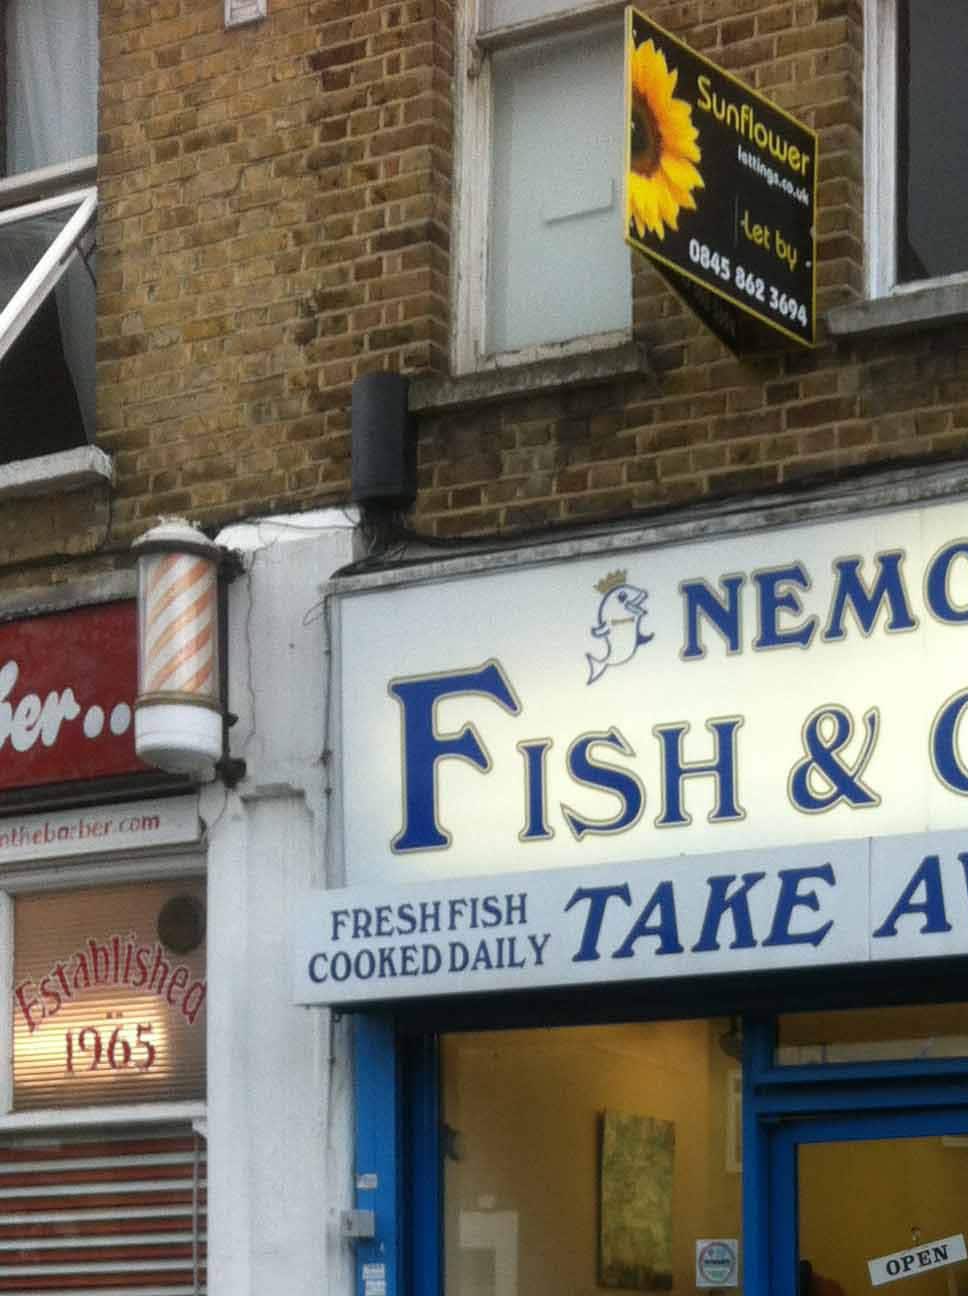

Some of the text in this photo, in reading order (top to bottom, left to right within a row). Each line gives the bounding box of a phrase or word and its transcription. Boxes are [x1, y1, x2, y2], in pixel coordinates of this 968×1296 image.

[697, 74, 810, 177] Sunflower
[737, 144, 810, 207] lettings.co.uk
[742, 209, 798, 273] Let by
[689, 238, 808, 328] 0845 862 3694
[787, 704, 881, 816] &
[331, 892, 528, 941] FRESH FISH
[563, 863, 838, 963] TAKE
[15, 931, 207, 1034] Established
[308, 932, 552, 984] COOKED DAILY
[66, 1023, 156, 1073] 1965
[885, 1244, 950, 1277] OPEN
